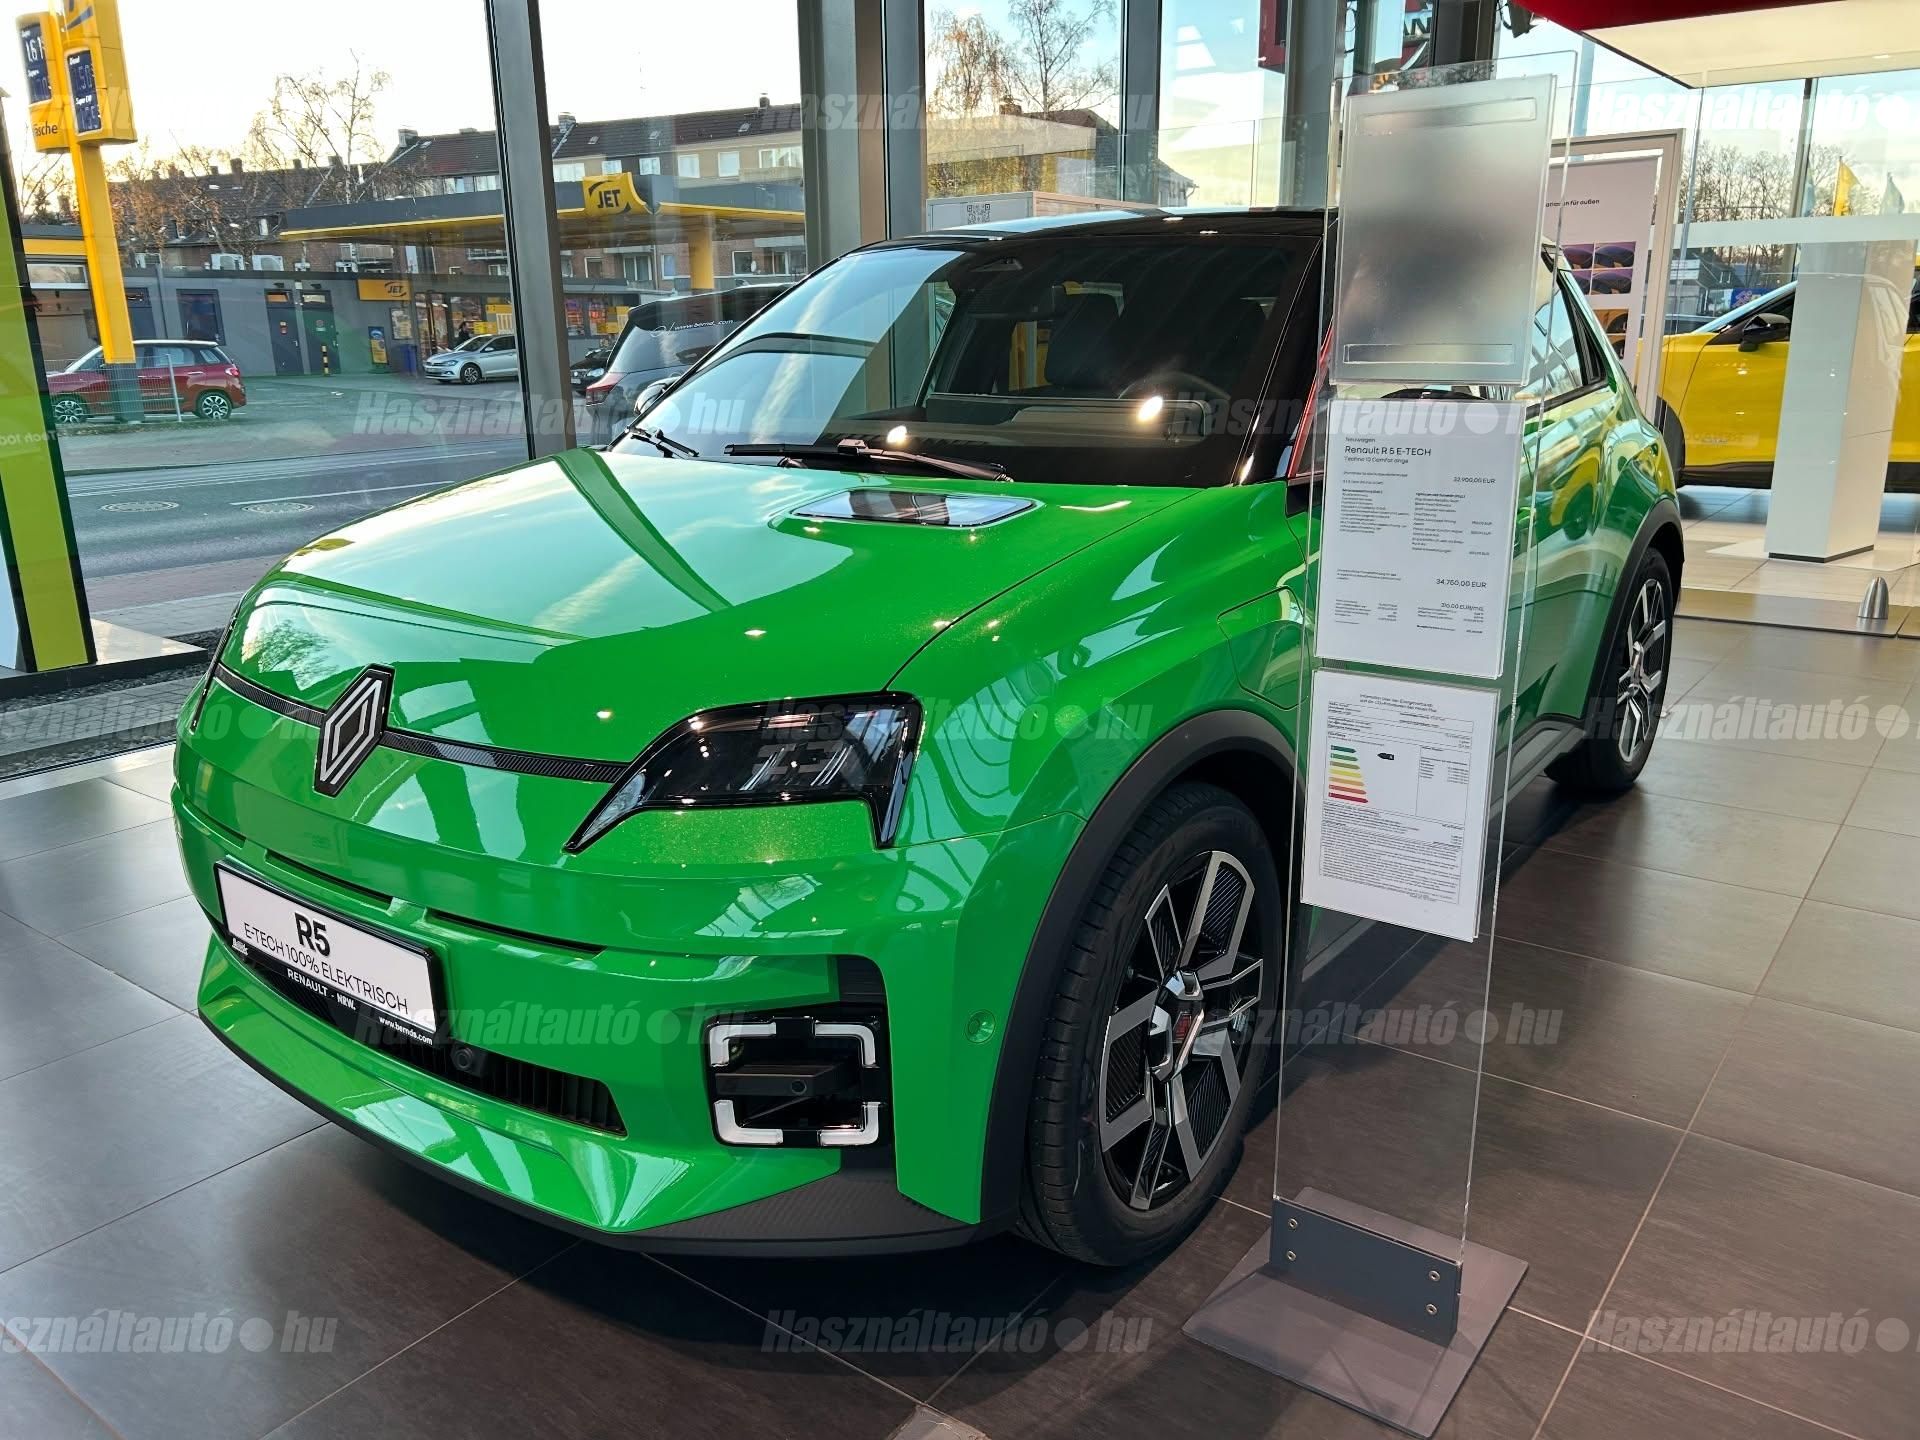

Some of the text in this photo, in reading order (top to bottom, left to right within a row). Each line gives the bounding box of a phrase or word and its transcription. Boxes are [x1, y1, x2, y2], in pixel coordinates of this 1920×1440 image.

[597, 189, 621, 208] JET
[1344, 446, 1432, 457] Renault R 5 E-TECH
[295, 912, 331, 957] R5
[243, 921, 286, 958] E-TECH
[285, 944, 320, 974] 100%
[321, 961, 409, 1015] ELEKTRISCH
[286, 968, 329, 997] RENAULT
